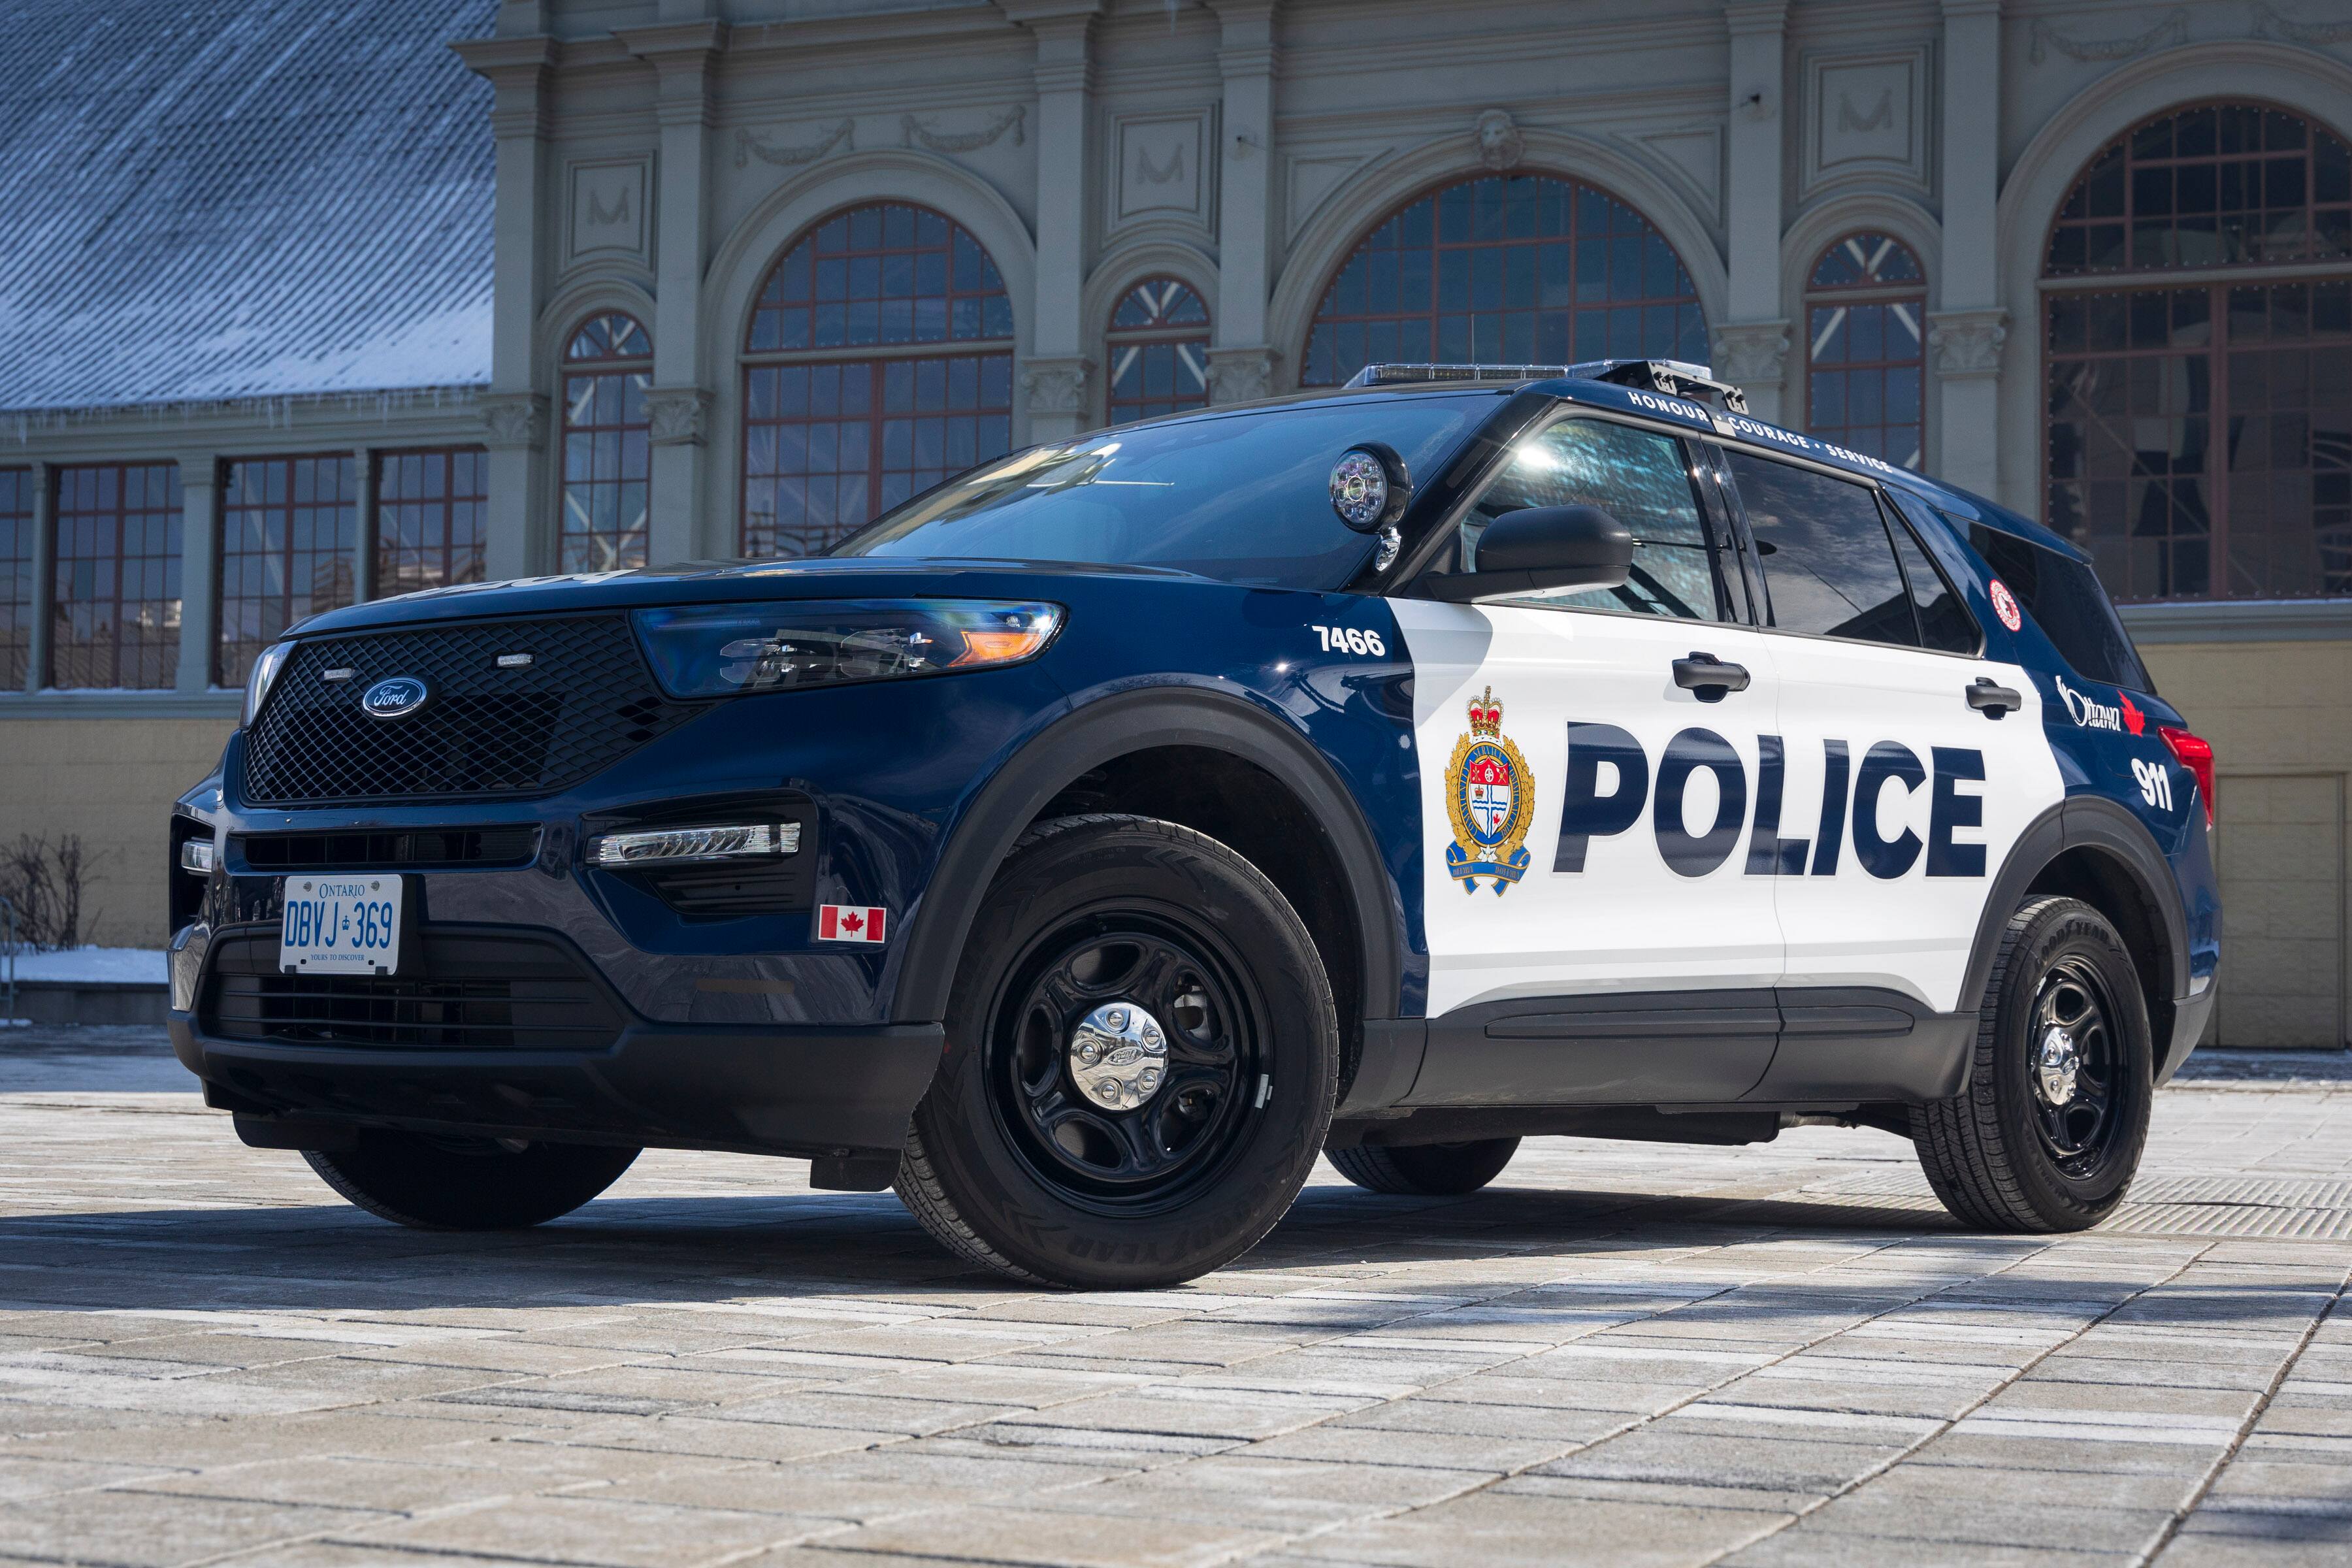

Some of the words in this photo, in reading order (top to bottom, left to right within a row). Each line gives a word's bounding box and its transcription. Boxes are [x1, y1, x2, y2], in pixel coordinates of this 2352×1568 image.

[1626, 391, 1710, 423] HONOUR
[1728, 416, 1810, 449] COURAGE
[1825, 444, 1893, 474] SERVICE
[1311, 625, 1386, 657] 7466
[374, 684, 407, 707] Ford
[2055, 675, 2121, 732] Ottawa
[1552, 721, 1987, 880] POLICE
[2131, 758, 2173, 811] 911
[319, 883, 365, 898] ONTARIO
[284, 900, 339, 947] DBVJ
[351, 902, 393, 948] 369
